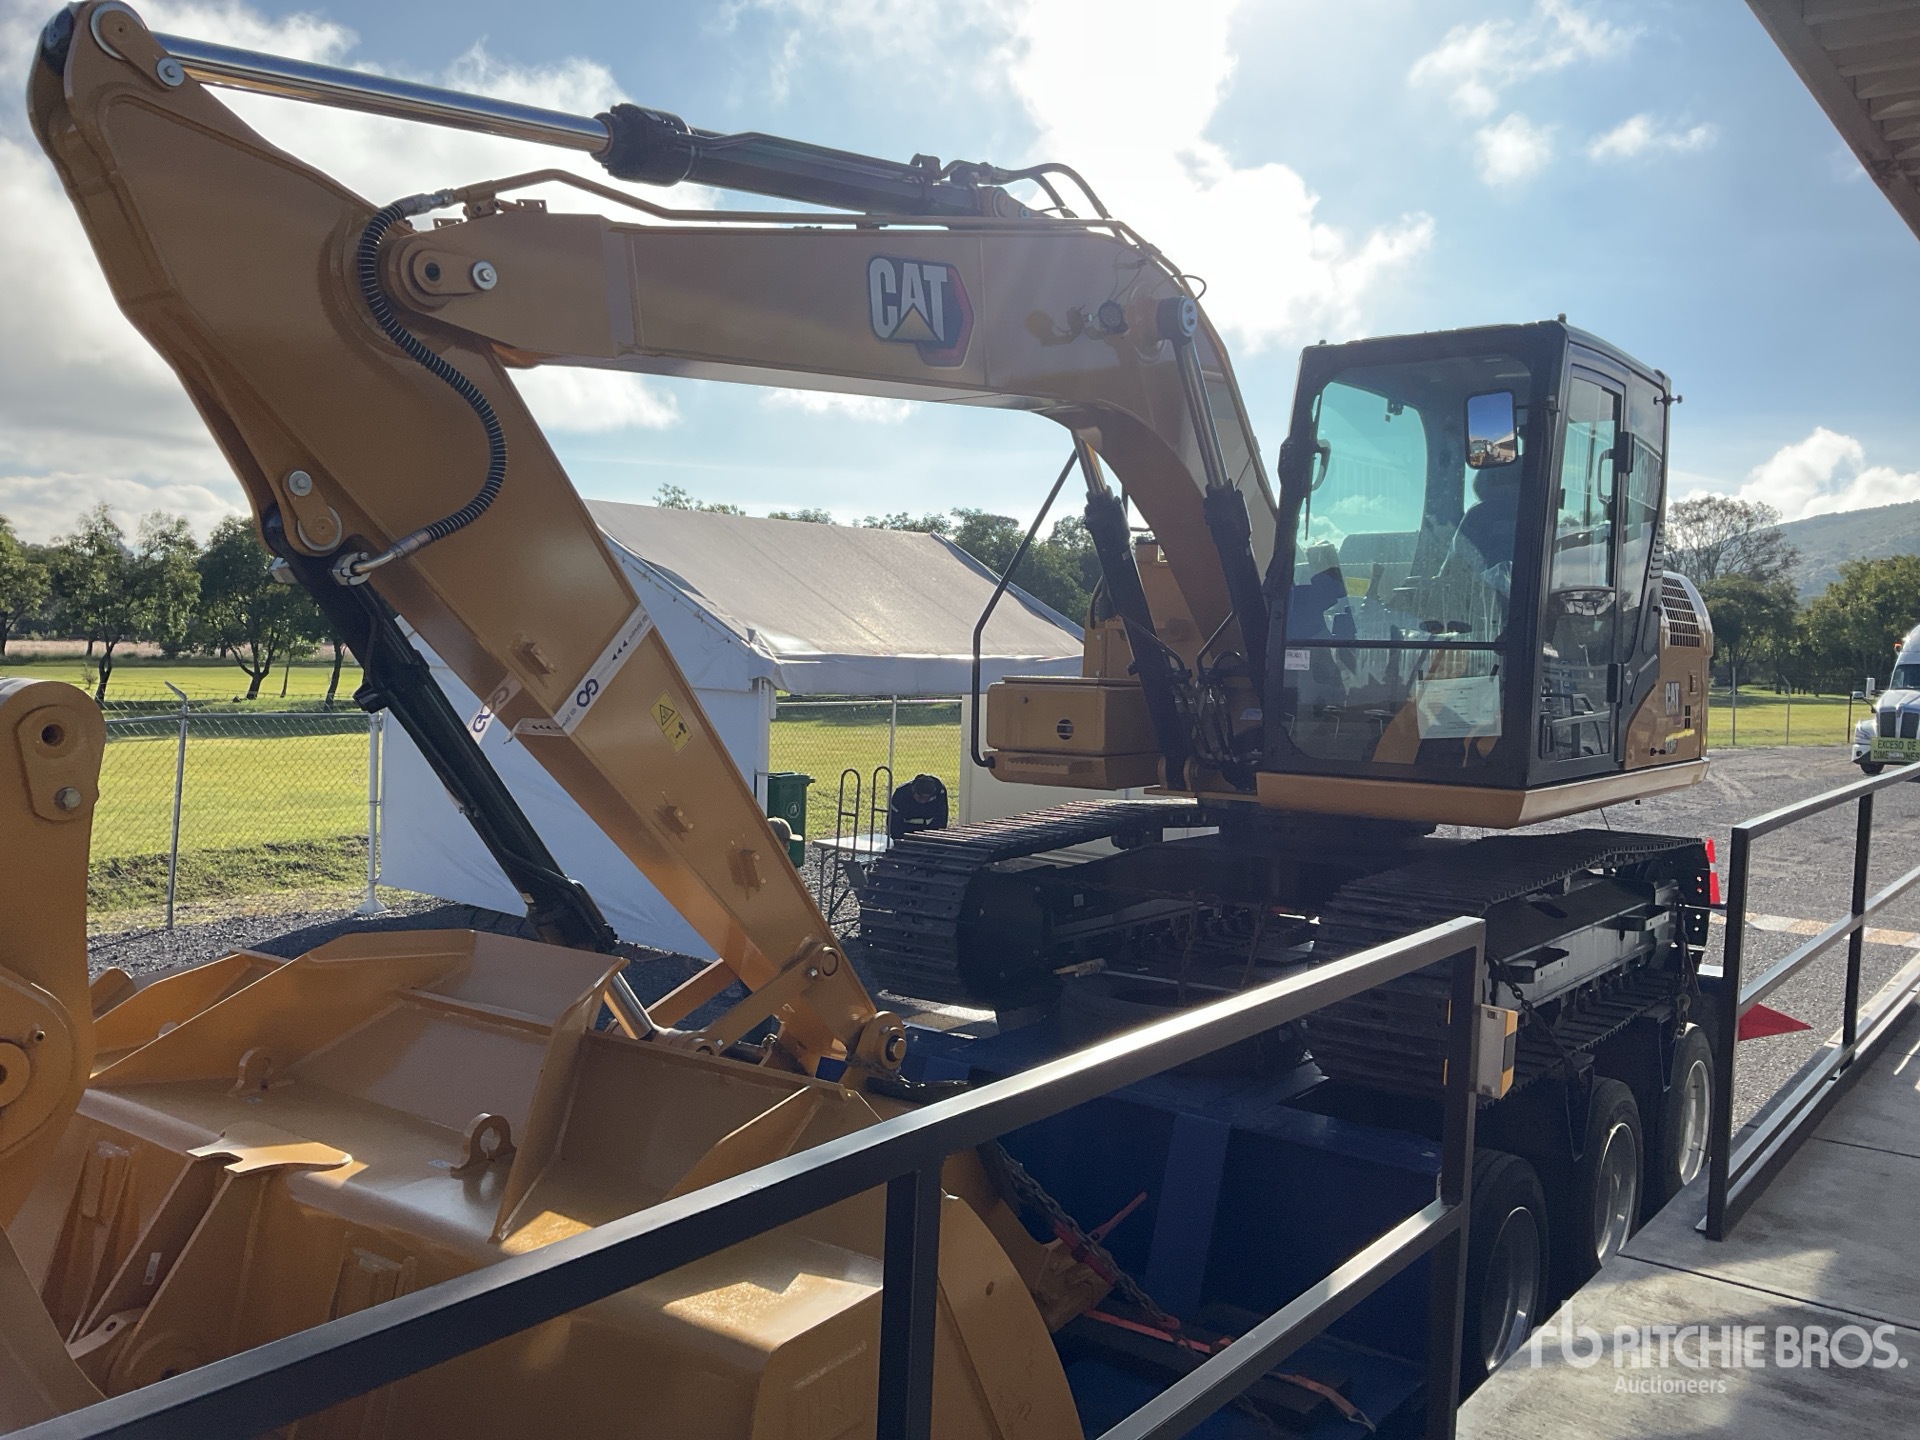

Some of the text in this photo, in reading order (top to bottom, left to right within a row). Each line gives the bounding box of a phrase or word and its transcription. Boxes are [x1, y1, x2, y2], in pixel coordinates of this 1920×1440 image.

[869, 257, 948, 342] CAT
[1665, 682, 1680, 716] CAT
[1877, 739, 1917, 750] EXCESO DE
